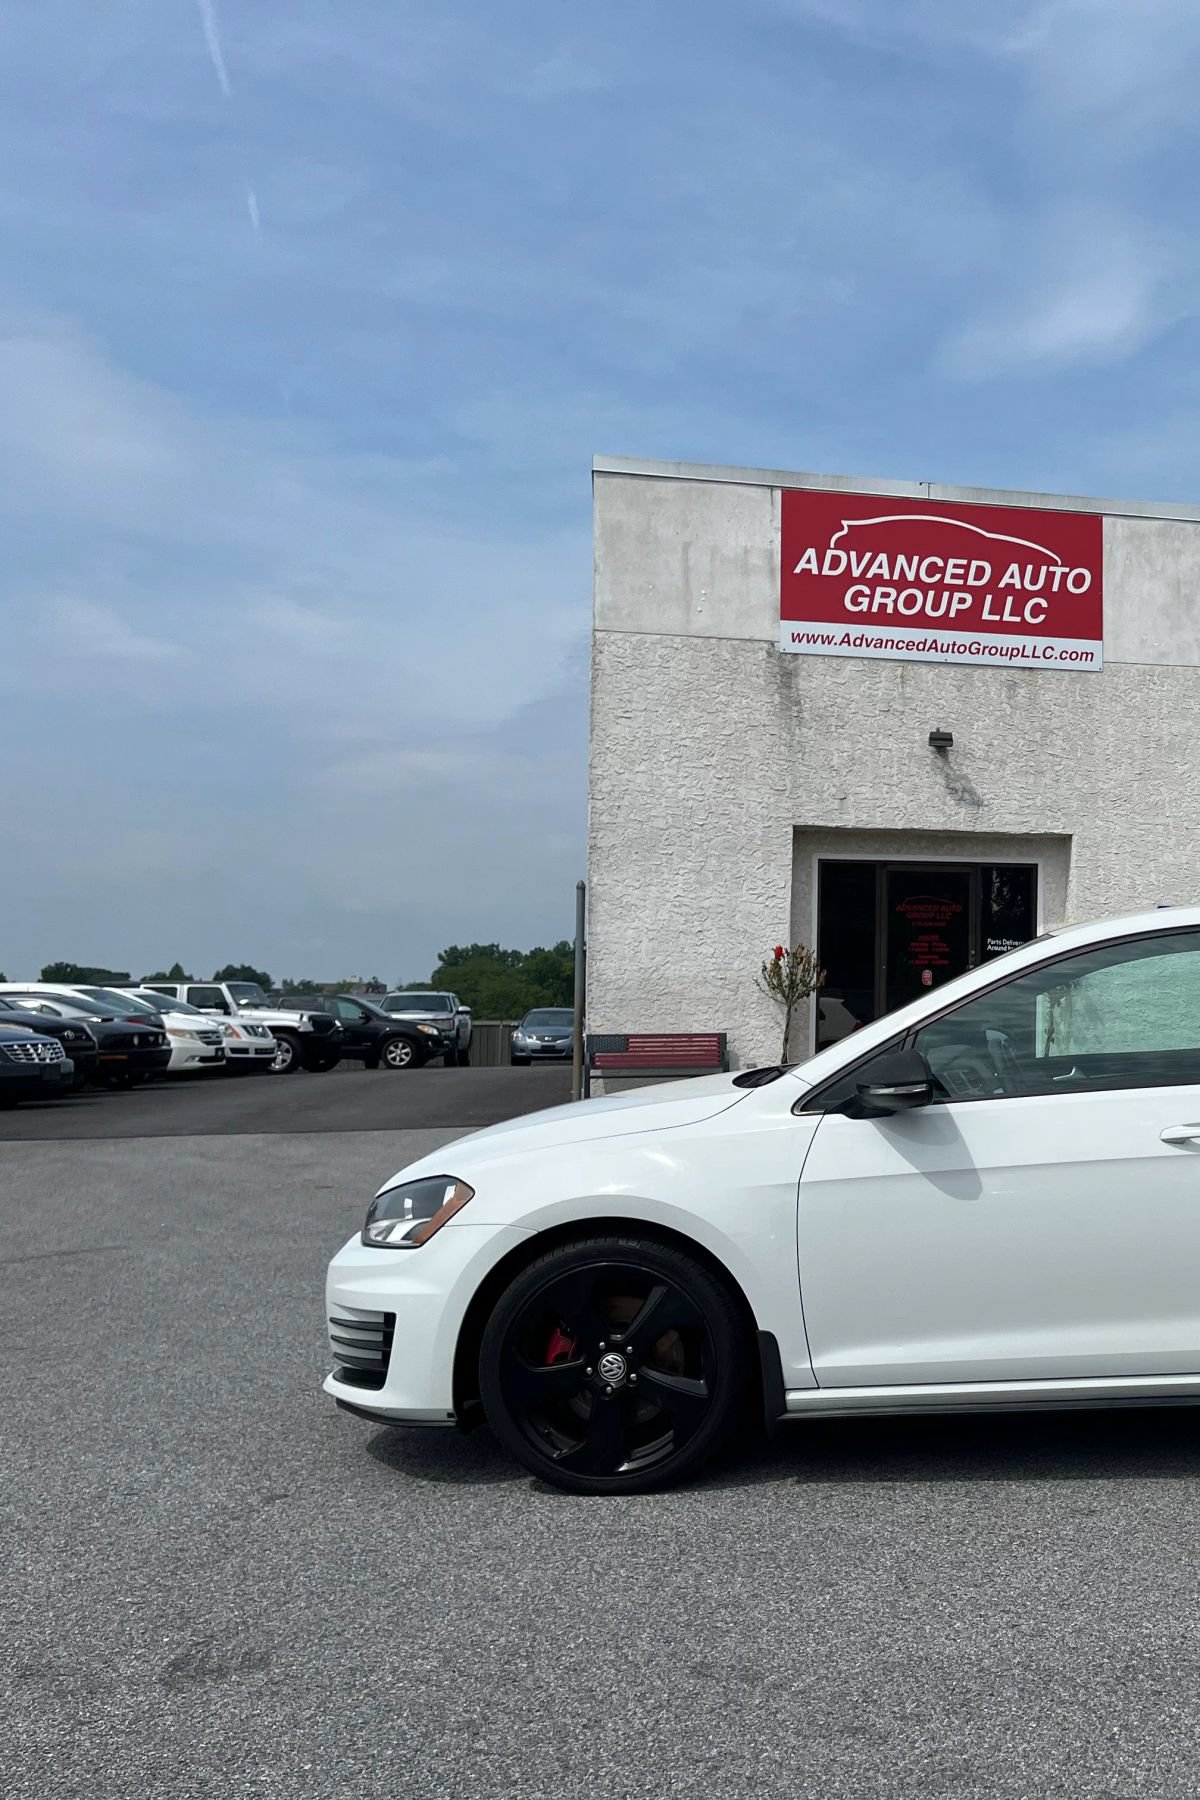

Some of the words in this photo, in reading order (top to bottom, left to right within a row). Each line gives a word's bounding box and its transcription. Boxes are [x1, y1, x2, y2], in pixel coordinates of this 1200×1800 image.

[793, 547, 992, 587] ADVANCED
[997, 563, 1092, 594] AUTO
[843, 584, 973, 619] GROUP
[981, 595, 1049, 624] LLC
[790, 630, 1095, 663] www.AdvancedAutoGroupLLC.com
[896, 904, 940, 912] ADVANCED
[936, 912, 953, 920] LLC
